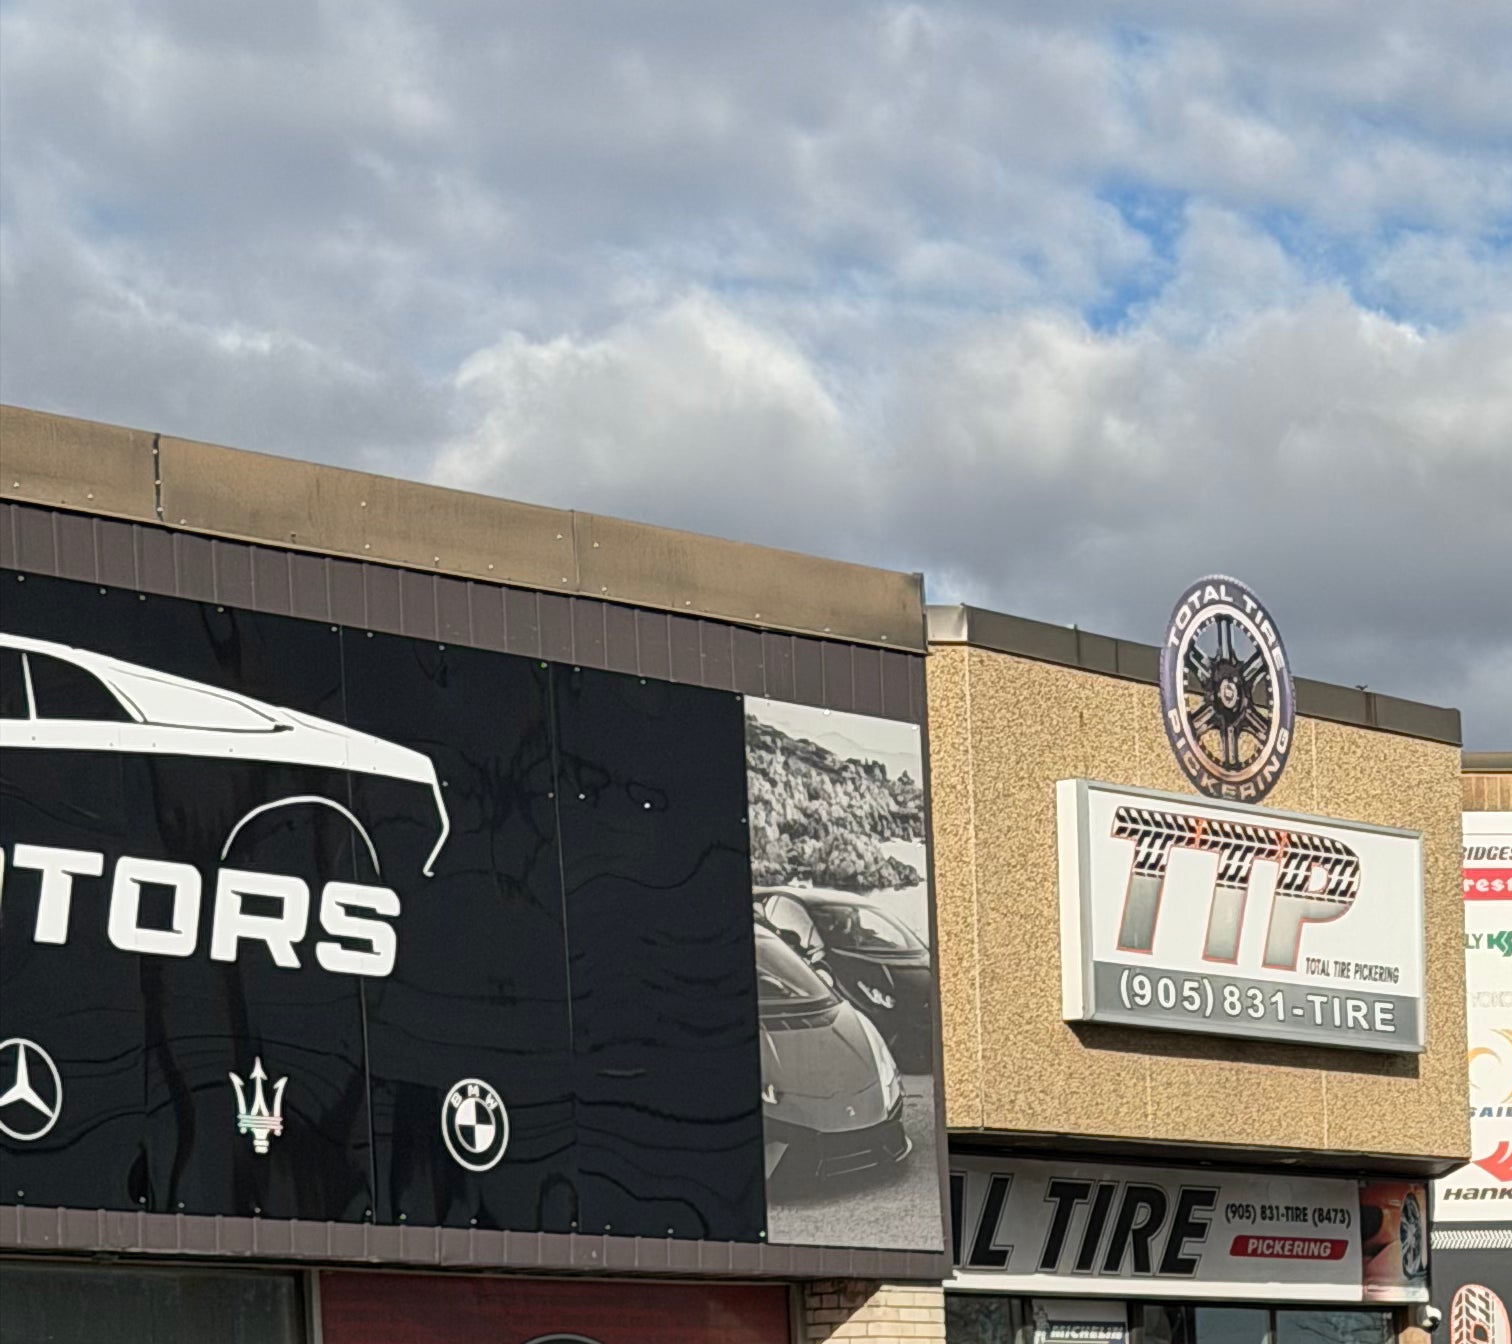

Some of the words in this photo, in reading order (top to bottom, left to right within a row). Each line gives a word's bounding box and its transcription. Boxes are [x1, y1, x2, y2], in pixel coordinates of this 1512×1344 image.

[1168, 584, 1233, 647] TOTAL
[1243, 594, 1286, 671] TIRE
[1168, 708, 1289, 800] PICKERING
[0, 843, 401, 977] TORS
[1111, 805, 1361, 971] TTP
[1306, 957, 1331, 977] TOTAL
[1333, 960, 1352, 980] TIRE
[1353, 962, 1400, 985] PICKERING
[451, 1085, 499, 1110] BMW
[1036, 1176, 1222, 1277] TIRE
[1224, 1202, 1257, 1224] (905)
[1260, 1205, 1309, 1223] 831-TIRE
[1312, 1206, 1351, 1227] (8473)
[1247, 1239, 1332, 1257] PICKERING
[1050, 1325, 1123, 1339] MICHELIN
